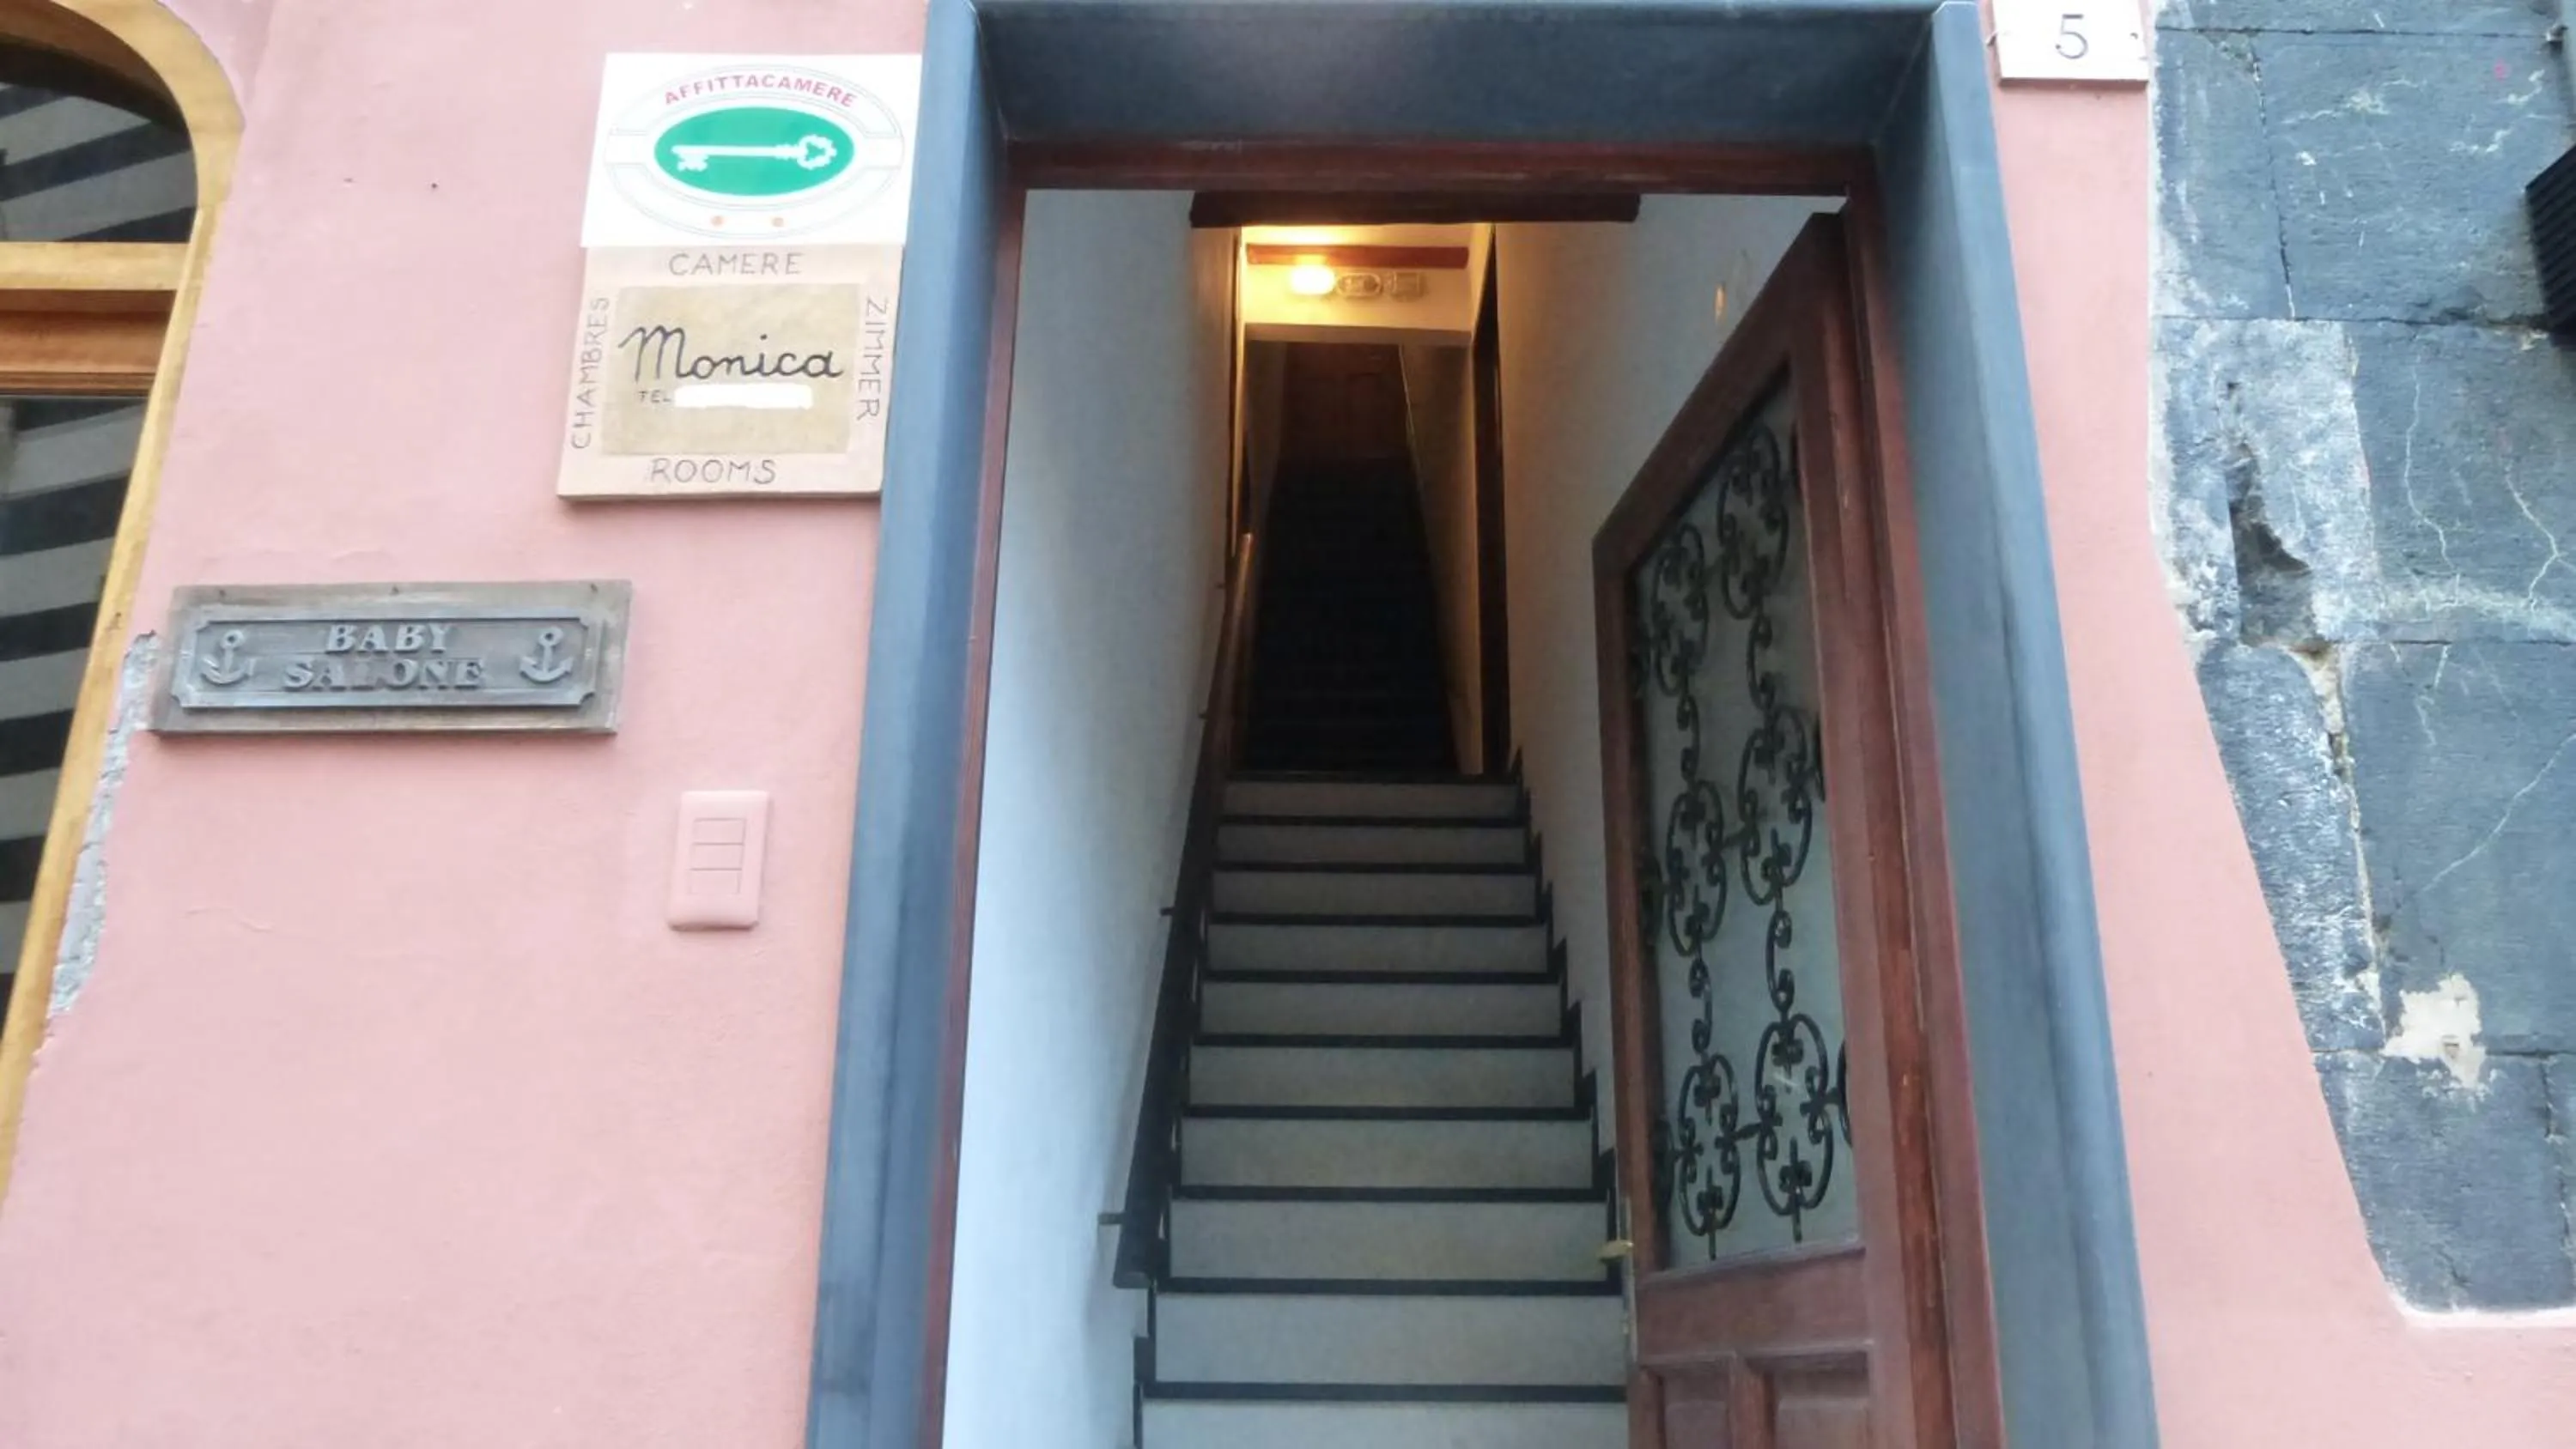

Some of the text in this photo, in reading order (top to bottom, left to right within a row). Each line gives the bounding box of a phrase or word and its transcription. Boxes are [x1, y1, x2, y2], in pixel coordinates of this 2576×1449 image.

[2055, 14, 2089, 59] 5
[664, 74, 857, 107] AFFITTACAMERE
[668, 252, 804, 276] CAMERE
[617, 324, 845, 385] Monica
[857, 297, 888, 421] ZIMMER
[571, 297, 611, 450] CHAMBRES
[649, 458, 777, 485] ROOMS
[325, 622, 456, 653] BABY
[283, 658, 484, 690] SALONE
